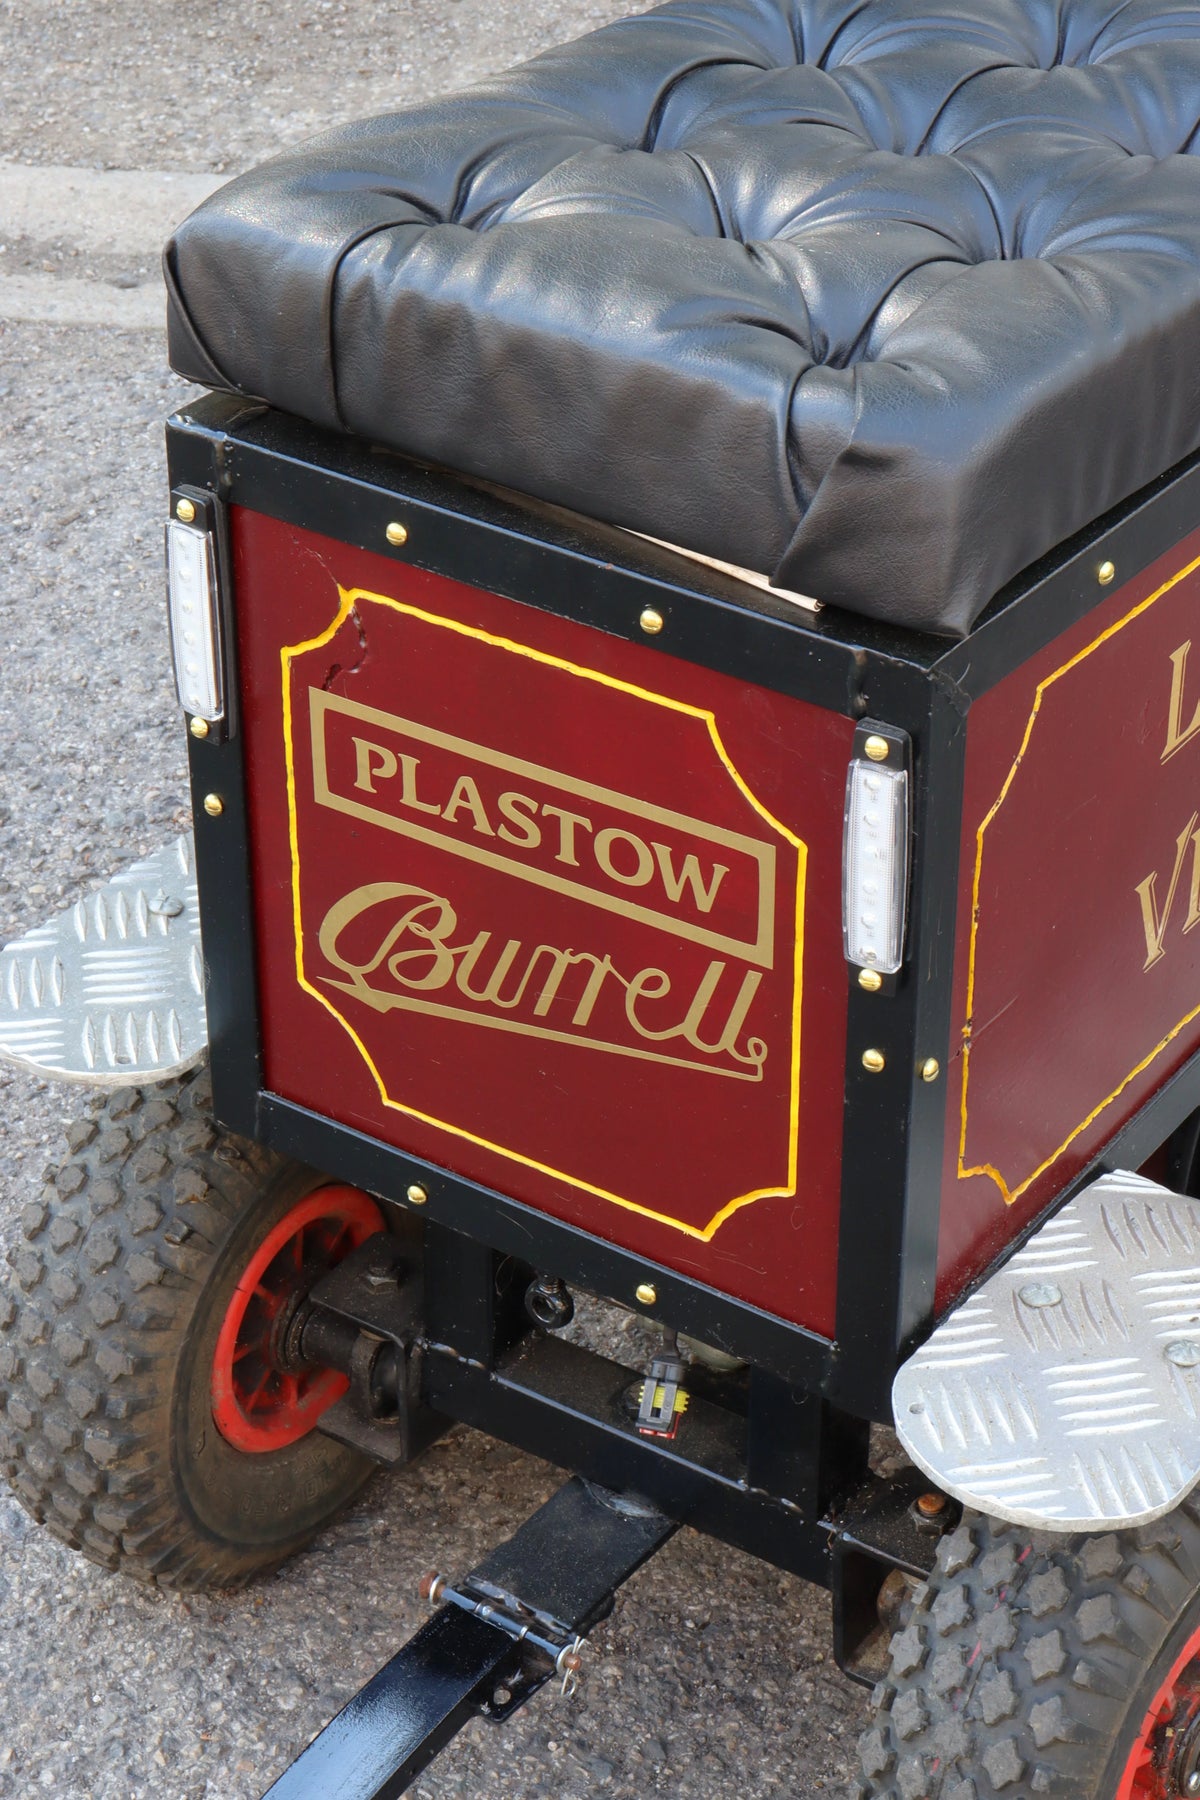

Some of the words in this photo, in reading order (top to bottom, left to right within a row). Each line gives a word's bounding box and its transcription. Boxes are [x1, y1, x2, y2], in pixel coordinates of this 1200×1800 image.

[351, 736, 730, 913] PLASTOW
[1134, 810, 1200, 974] V
[318, 882, 768, 1070] Burrell
